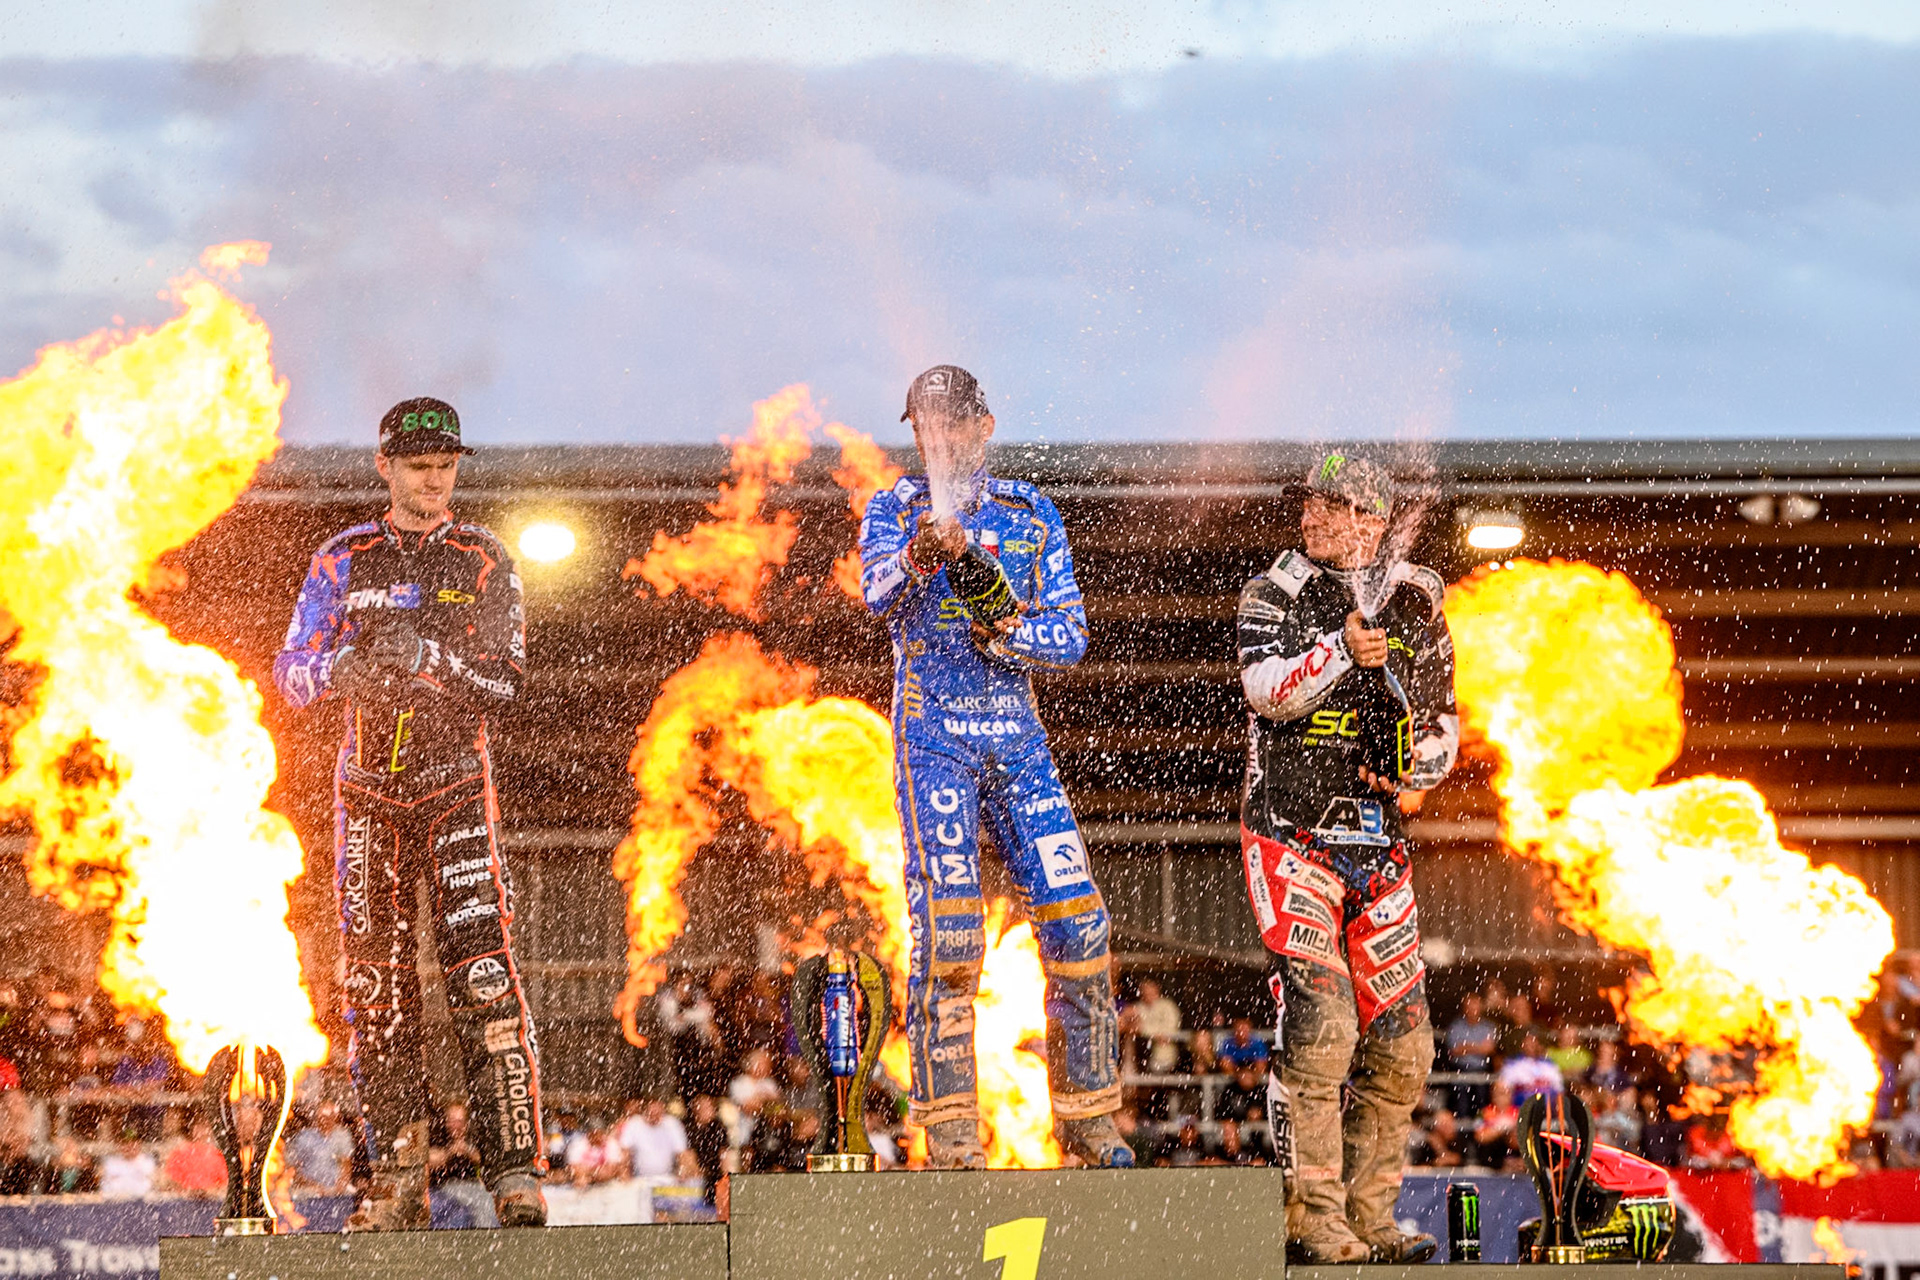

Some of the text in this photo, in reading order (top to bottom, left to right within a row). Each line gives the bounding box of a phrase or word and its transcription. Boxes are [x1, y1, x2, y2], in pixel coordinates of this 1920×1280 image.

[449, 824, 489, 844] ANLAS
[442, 855, 494, 880] Richard
[1054, 864, 1084, 878] ORLEN
[449, 870, 492, 891] Hayes
[446, 902, 499, 926] MOTOREX
[932, 1045, 974, 1064] ORLE
[505, 1053, 533, 1151] Choices
[983, 1216, 1048, 1280] 1
